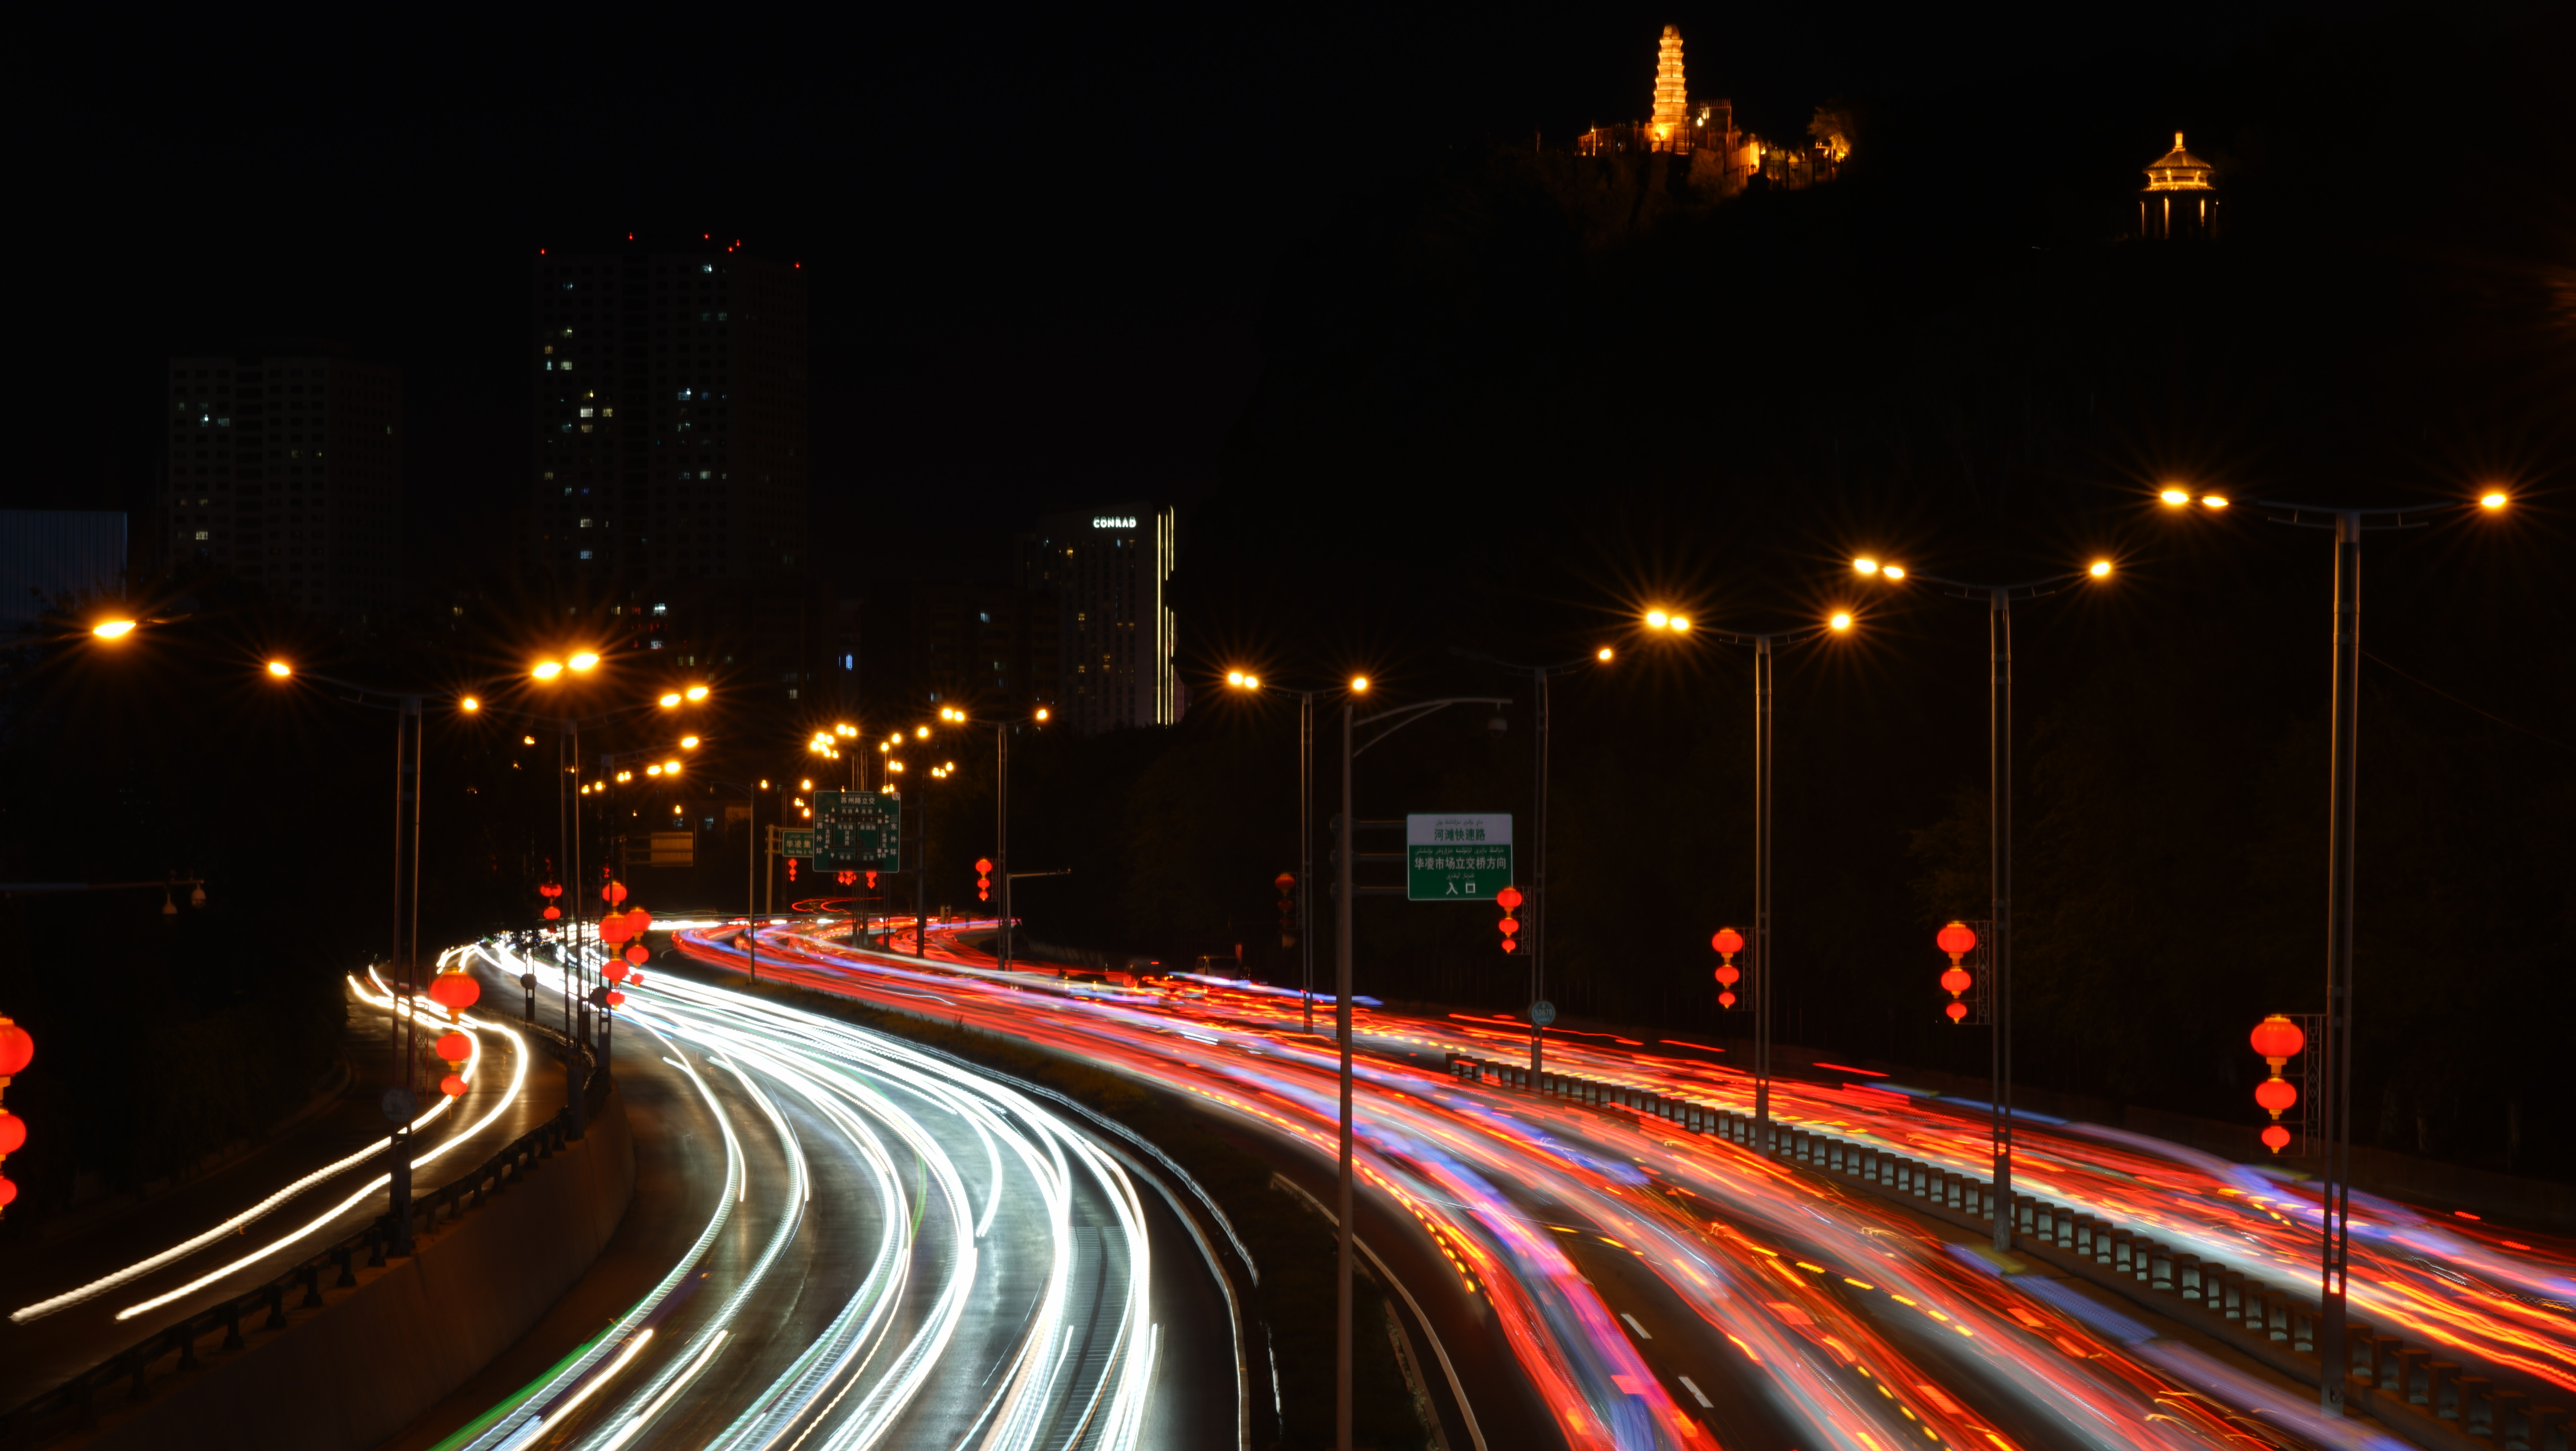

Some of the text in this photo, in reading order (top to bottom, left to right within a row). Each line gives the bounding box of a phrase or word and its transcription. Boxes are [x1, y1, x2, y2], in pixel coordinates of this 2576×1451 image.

[1093, 518, 1136, 528] CONRAD
[1434, 828, 1485, 842] 河滩快速路
[1415, 857, 1506, 871] 华凌市场立交桥方向
[1446, 882, 1476, 895] 入口
